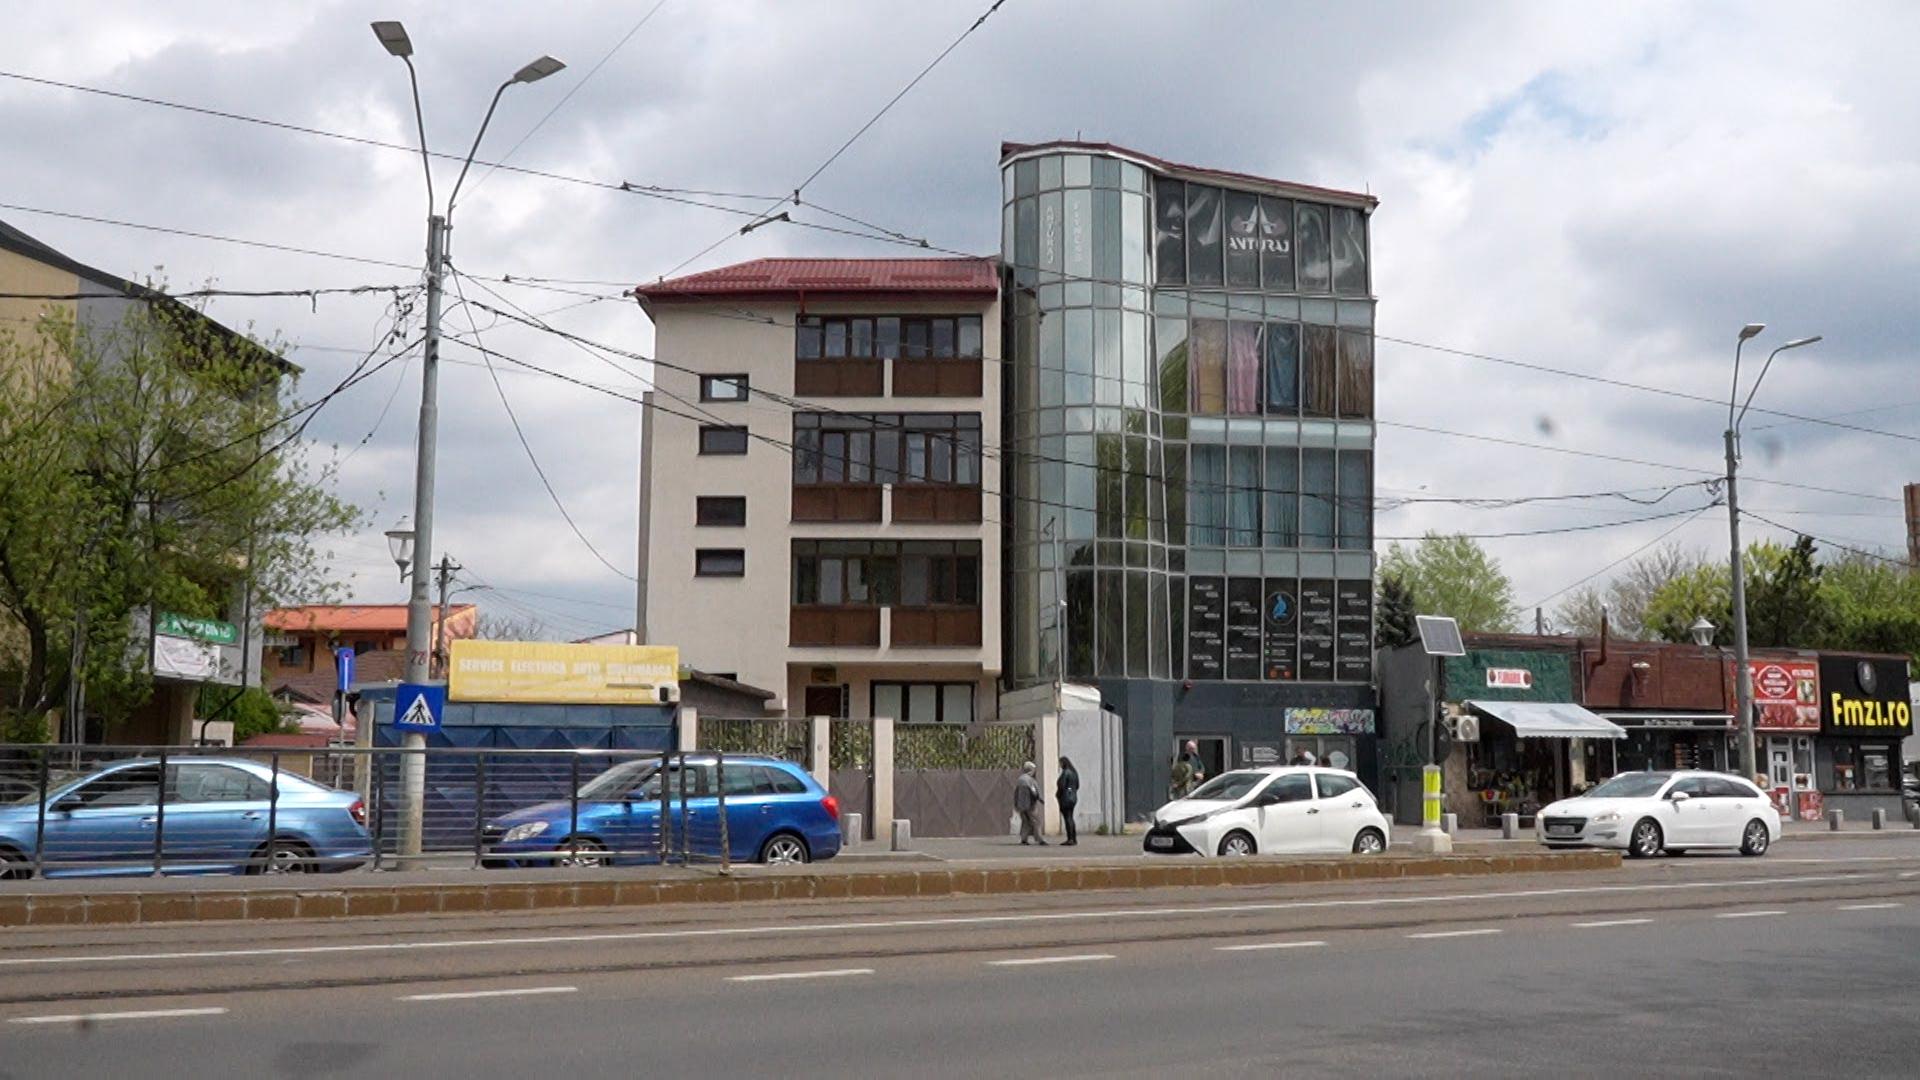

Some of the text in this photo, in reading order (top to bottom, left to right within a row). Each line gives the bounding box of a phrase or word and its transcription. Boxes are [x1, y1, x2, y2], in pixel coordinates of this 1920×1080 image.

[1229, 237, 1290, 253] ANTURAJ
[459, 658, 505, 673] SERVICE
[511, 659, 566, 675] ELECTRICA
